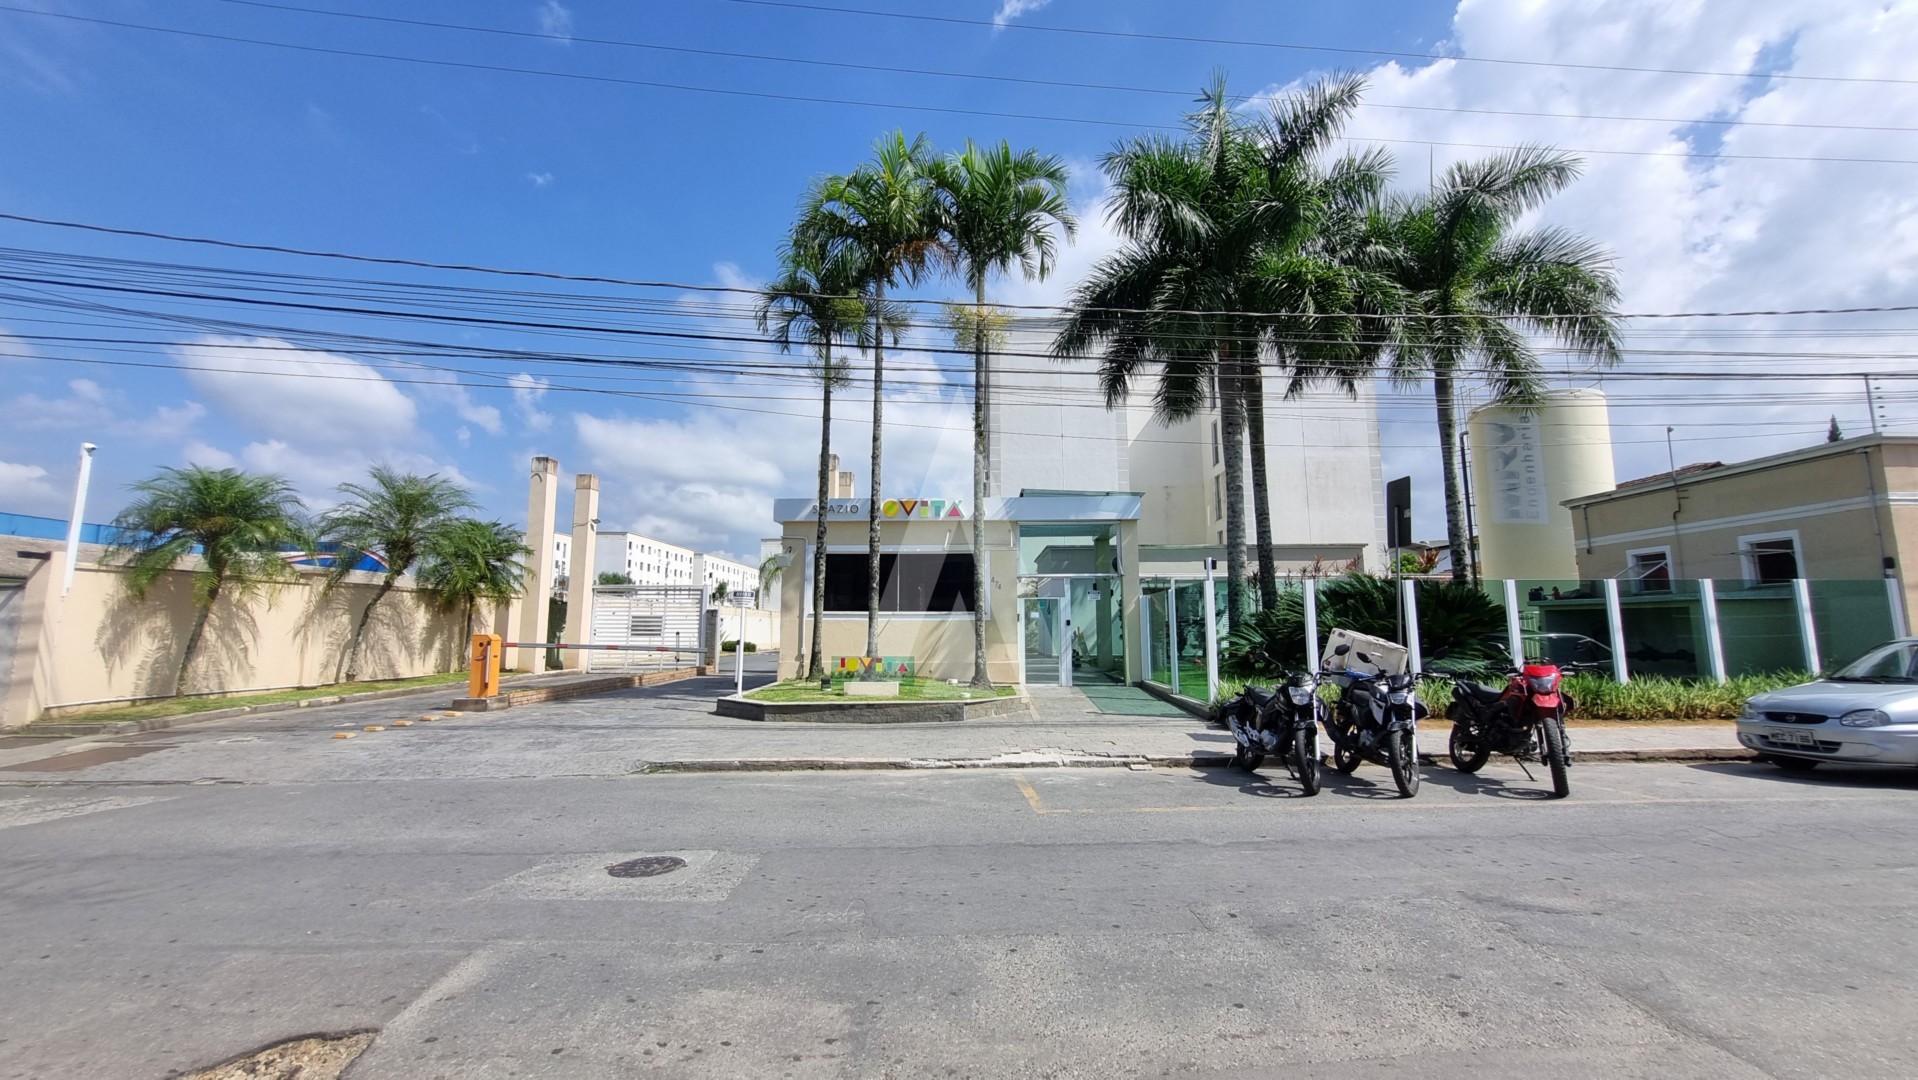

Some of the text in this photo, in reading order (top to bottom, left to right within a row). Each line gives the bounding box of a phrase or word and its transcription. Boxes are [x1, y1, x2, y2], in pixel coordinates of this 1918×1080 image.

[1517, 415, 1540, 519] Engenharia
[812, 500, 965, 518] SAZIO OVITA
[990, 576, 1002, 591] 474
[836, 657, 909, 673] JOVITA
